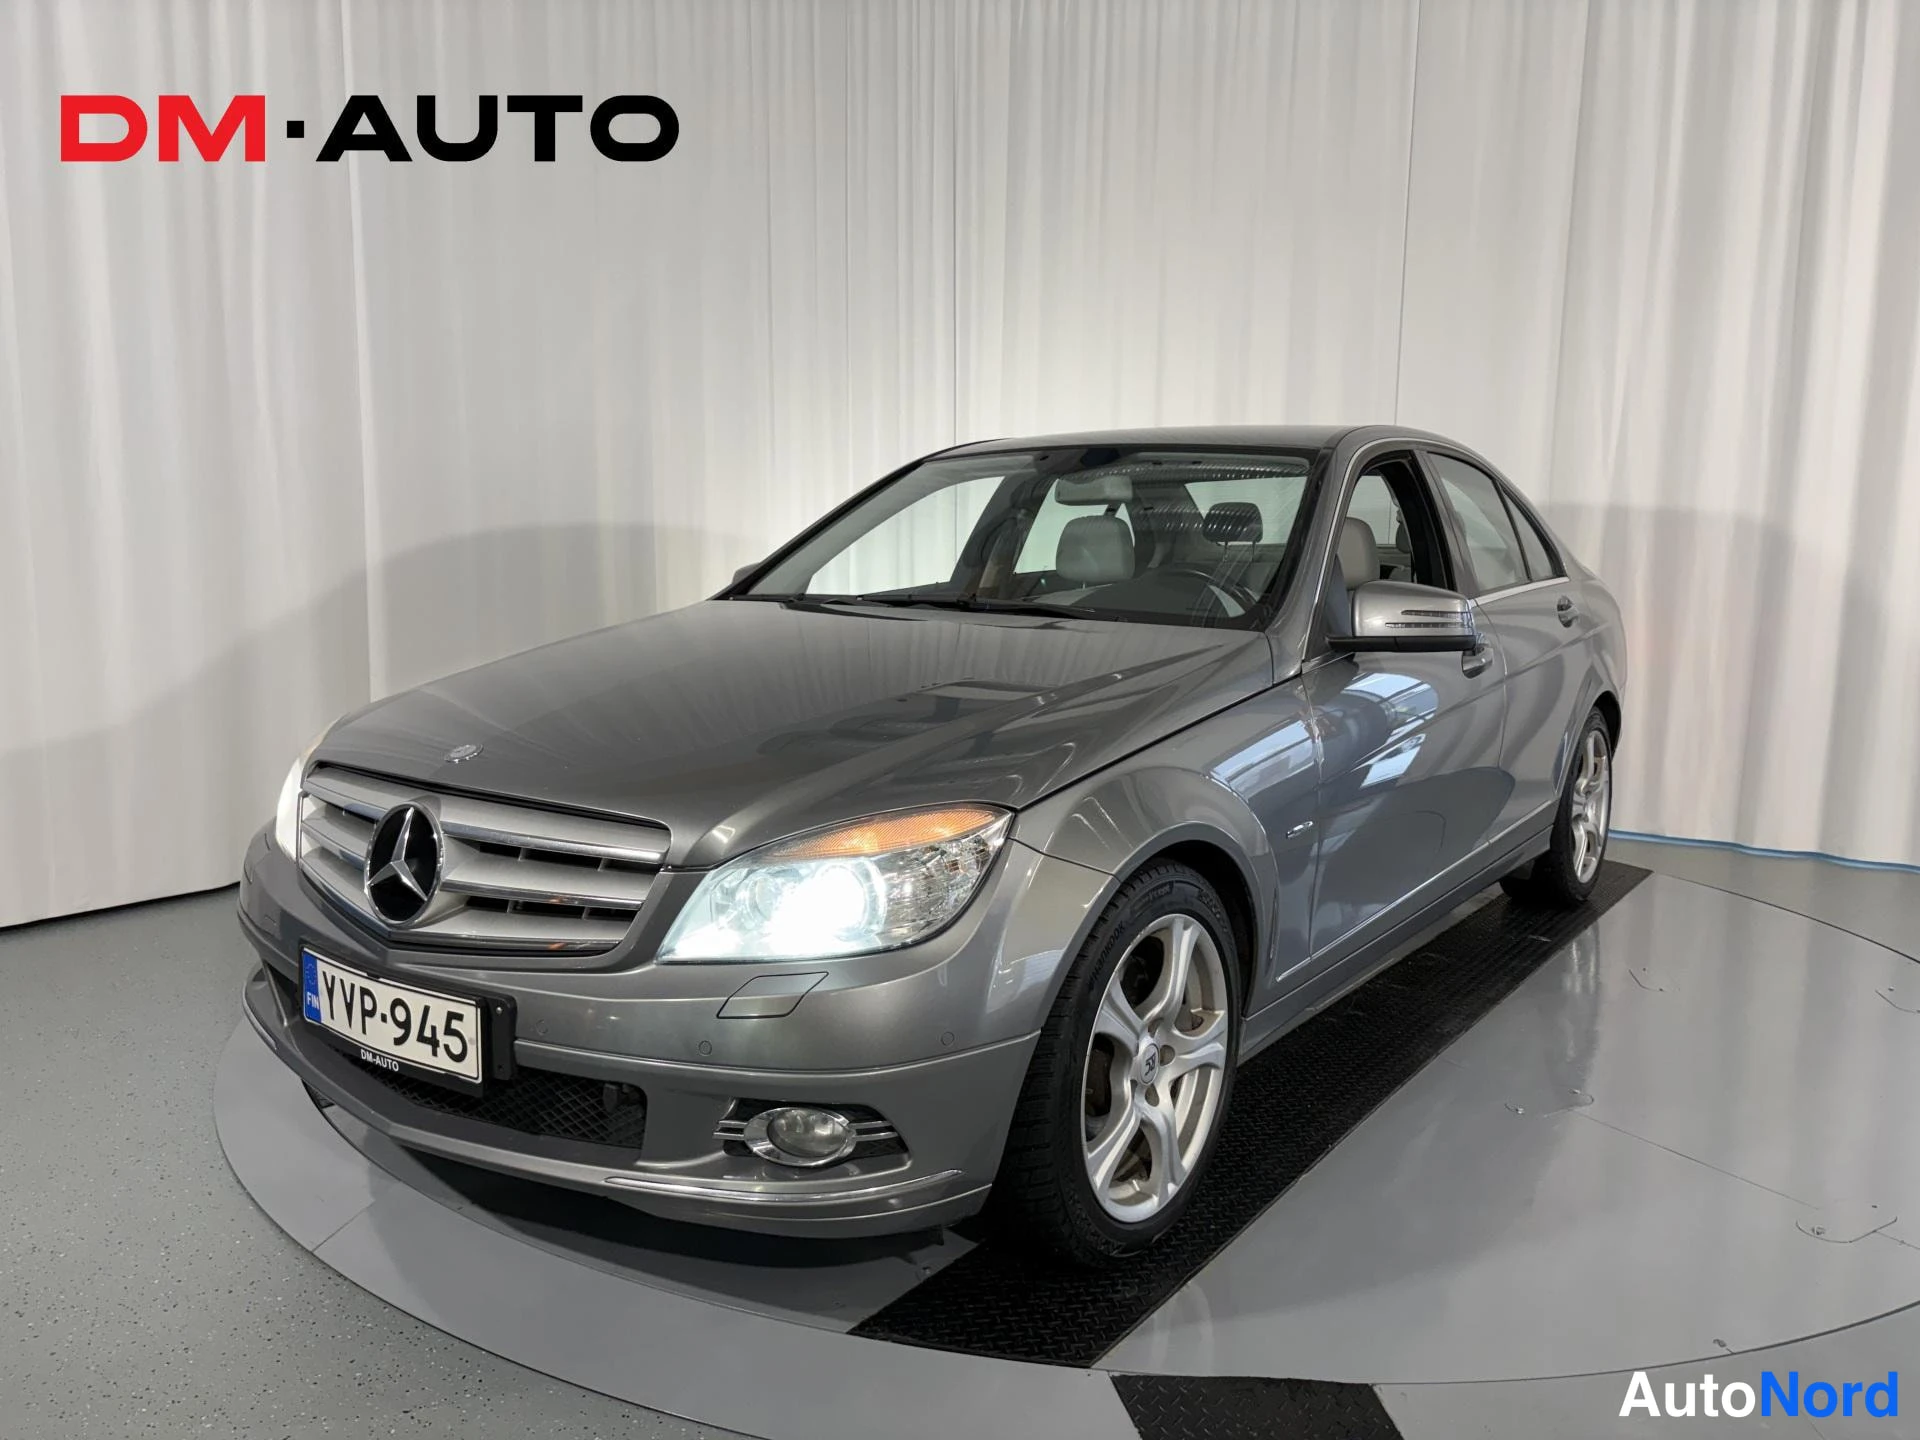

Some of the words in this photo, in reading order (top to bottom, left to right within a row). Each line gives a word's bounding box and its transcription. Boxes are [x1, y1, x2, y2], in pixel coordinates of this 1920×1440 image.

[306, 992, 321, 1011] FIN
[322, 970, 468, 1063] YVP-945
[360, 1049, 400, 1072] DM-AUTO
